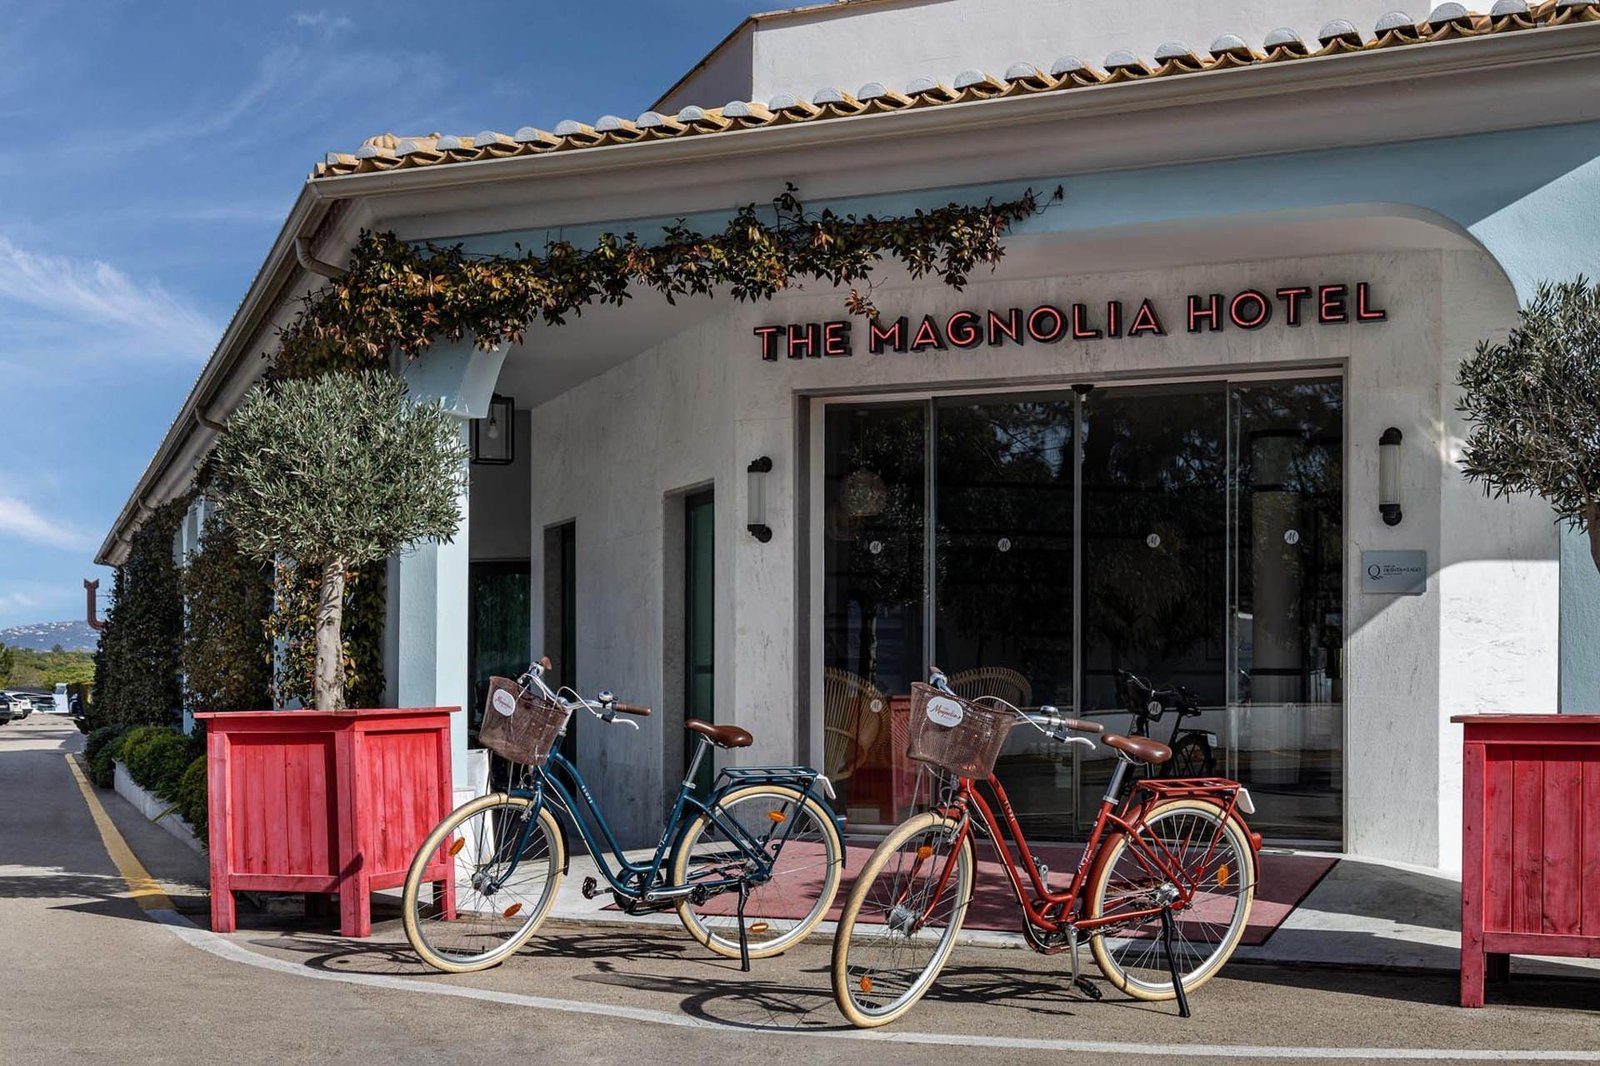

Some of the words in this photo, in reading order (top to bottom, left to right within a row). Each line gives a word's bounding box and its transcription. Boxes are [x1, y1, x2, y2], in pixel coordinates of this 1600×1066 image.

[754, 320, 852, 361] THE
[869, 298, 1167, 354] MAGNOLIA
[1187, 282, 1387, 333] HOTEL
